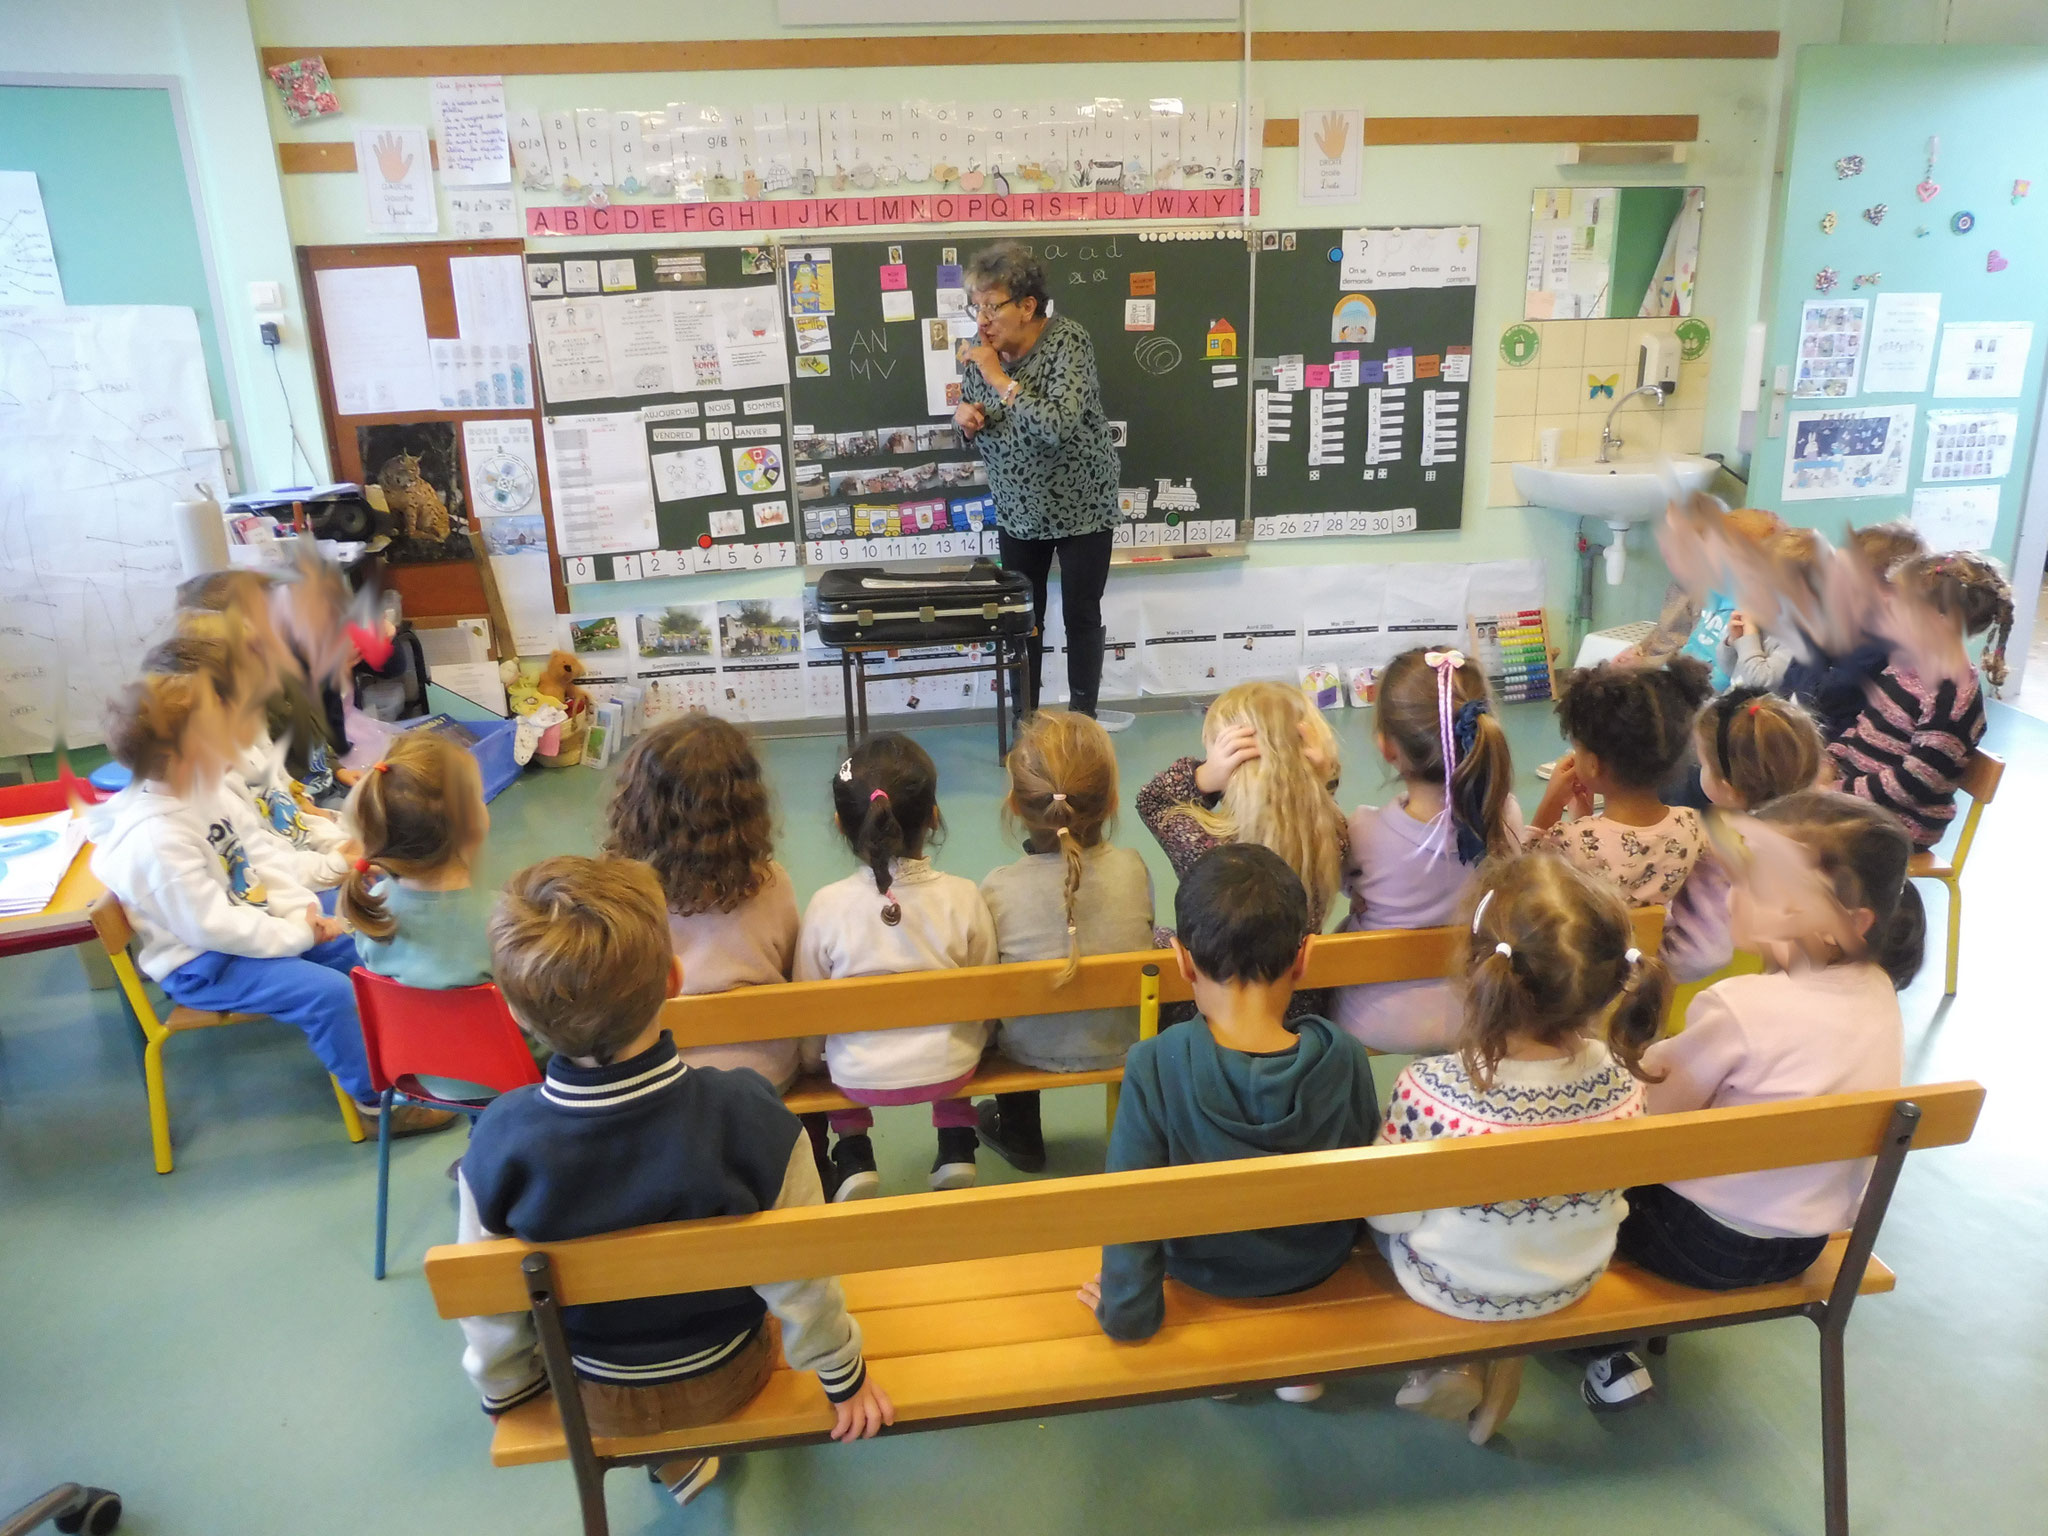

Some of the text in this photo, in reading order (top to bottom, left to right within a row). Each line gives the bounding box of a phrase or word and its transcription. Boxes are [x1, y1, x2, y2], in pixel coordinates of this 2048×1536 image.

[534, 211, 549, 231] A
[564, 210, 579, 231] B
[593, 208, 609, 230] C
[623, 209, 639, 229] D
[651, 209, 667, 229] E
[683, 207, 696, 228] F
[708, 206, 725, 227] G
[739, 205, 754, 226] H
[798, 204, 809, 224] J
[825, 202, 839, 222] K
[856, 201, 869, 221] L
[882, 200, 899, 220] M
[910, 199, 925, 219] N
[936, 198, 954, 219] O
[968, 199, 982, 218] P
[990, 196, 1008, 218] Q
[1022, 198, 1035, 218] R
[1049, 196, 1062, 216] S
[1076, 196, 1089, 214] T
[1104, 196, 1116, 216] U
[1132, 196, 1144, 215] V
[1156, 196, 1174, 214] W
[1187, 195, 1199, 214] X
[1212, 194, 1226, 212] Y
[1360, 240, 1369, 256] ?
[1376, 270, 1386, 278] On
[708, 404, 732, 412] NOUS
[747, 402, 780, 412] SOMMES
[654, 432, 694, 440] VENDREDI
[736, 428, 768, 437] JANVIER
[1257, 514, 1413, 537] 25 26 27 28 29 30 31
[1114, 525, 1232, 544] 20 21 22 23 24
[814, 547, 824, 561] 8
[839, 546, 849, 560] 9
[861, 544, 878, 558] 10
[886, 544, 901, 557] 11
[912, 543, 927, 556] 12
[936, 540, 952, 553] 13
[960, 538, 976, 551] 14
[576, 549, 787, 576] 0 1 2 3 4 5 6 7
